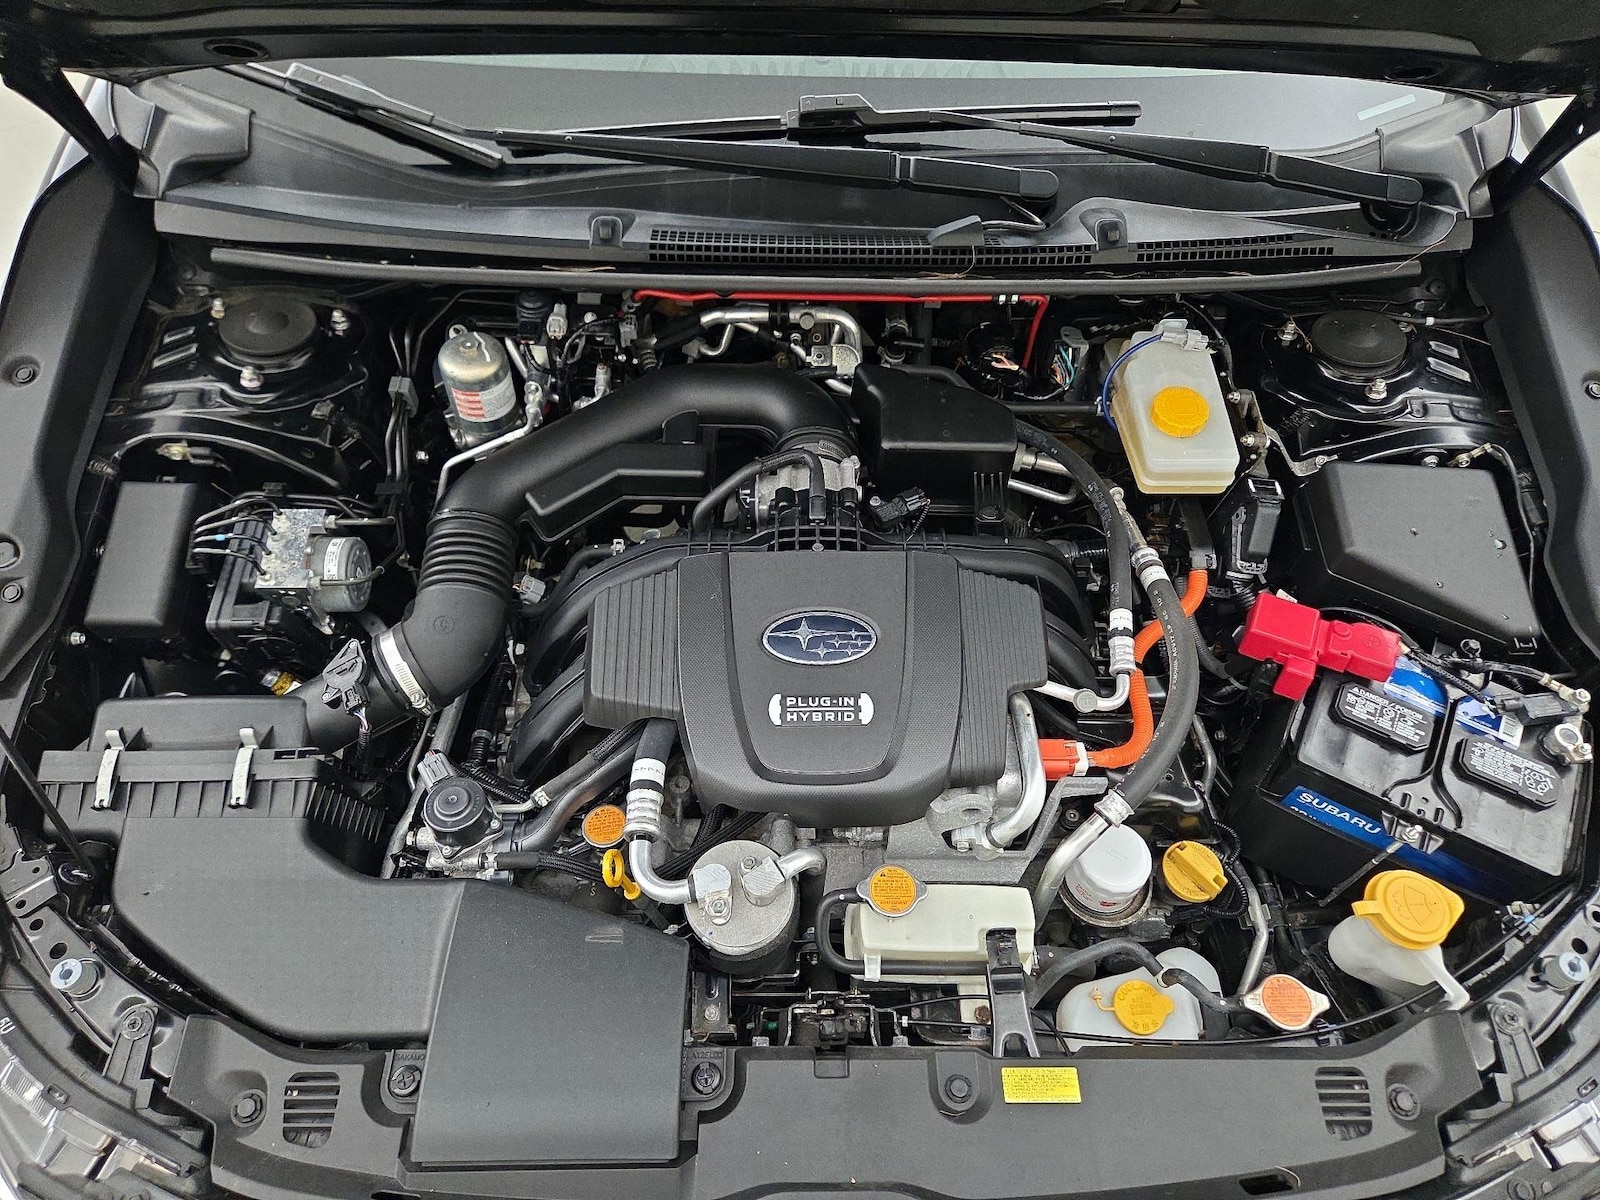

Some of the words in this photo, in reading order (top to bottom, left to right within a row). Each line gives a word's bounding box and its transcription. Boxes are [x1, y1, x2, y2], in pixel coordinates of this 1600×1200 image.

[786, 697, 854, 707] PLUG-IN
[1360, 688, 1389, 706] DANGER
[1395, 704, 1423, 720] POISON
[786, 712, 855, 722] HYBRID
[1299, 792, 1382, 834] SUBARU
